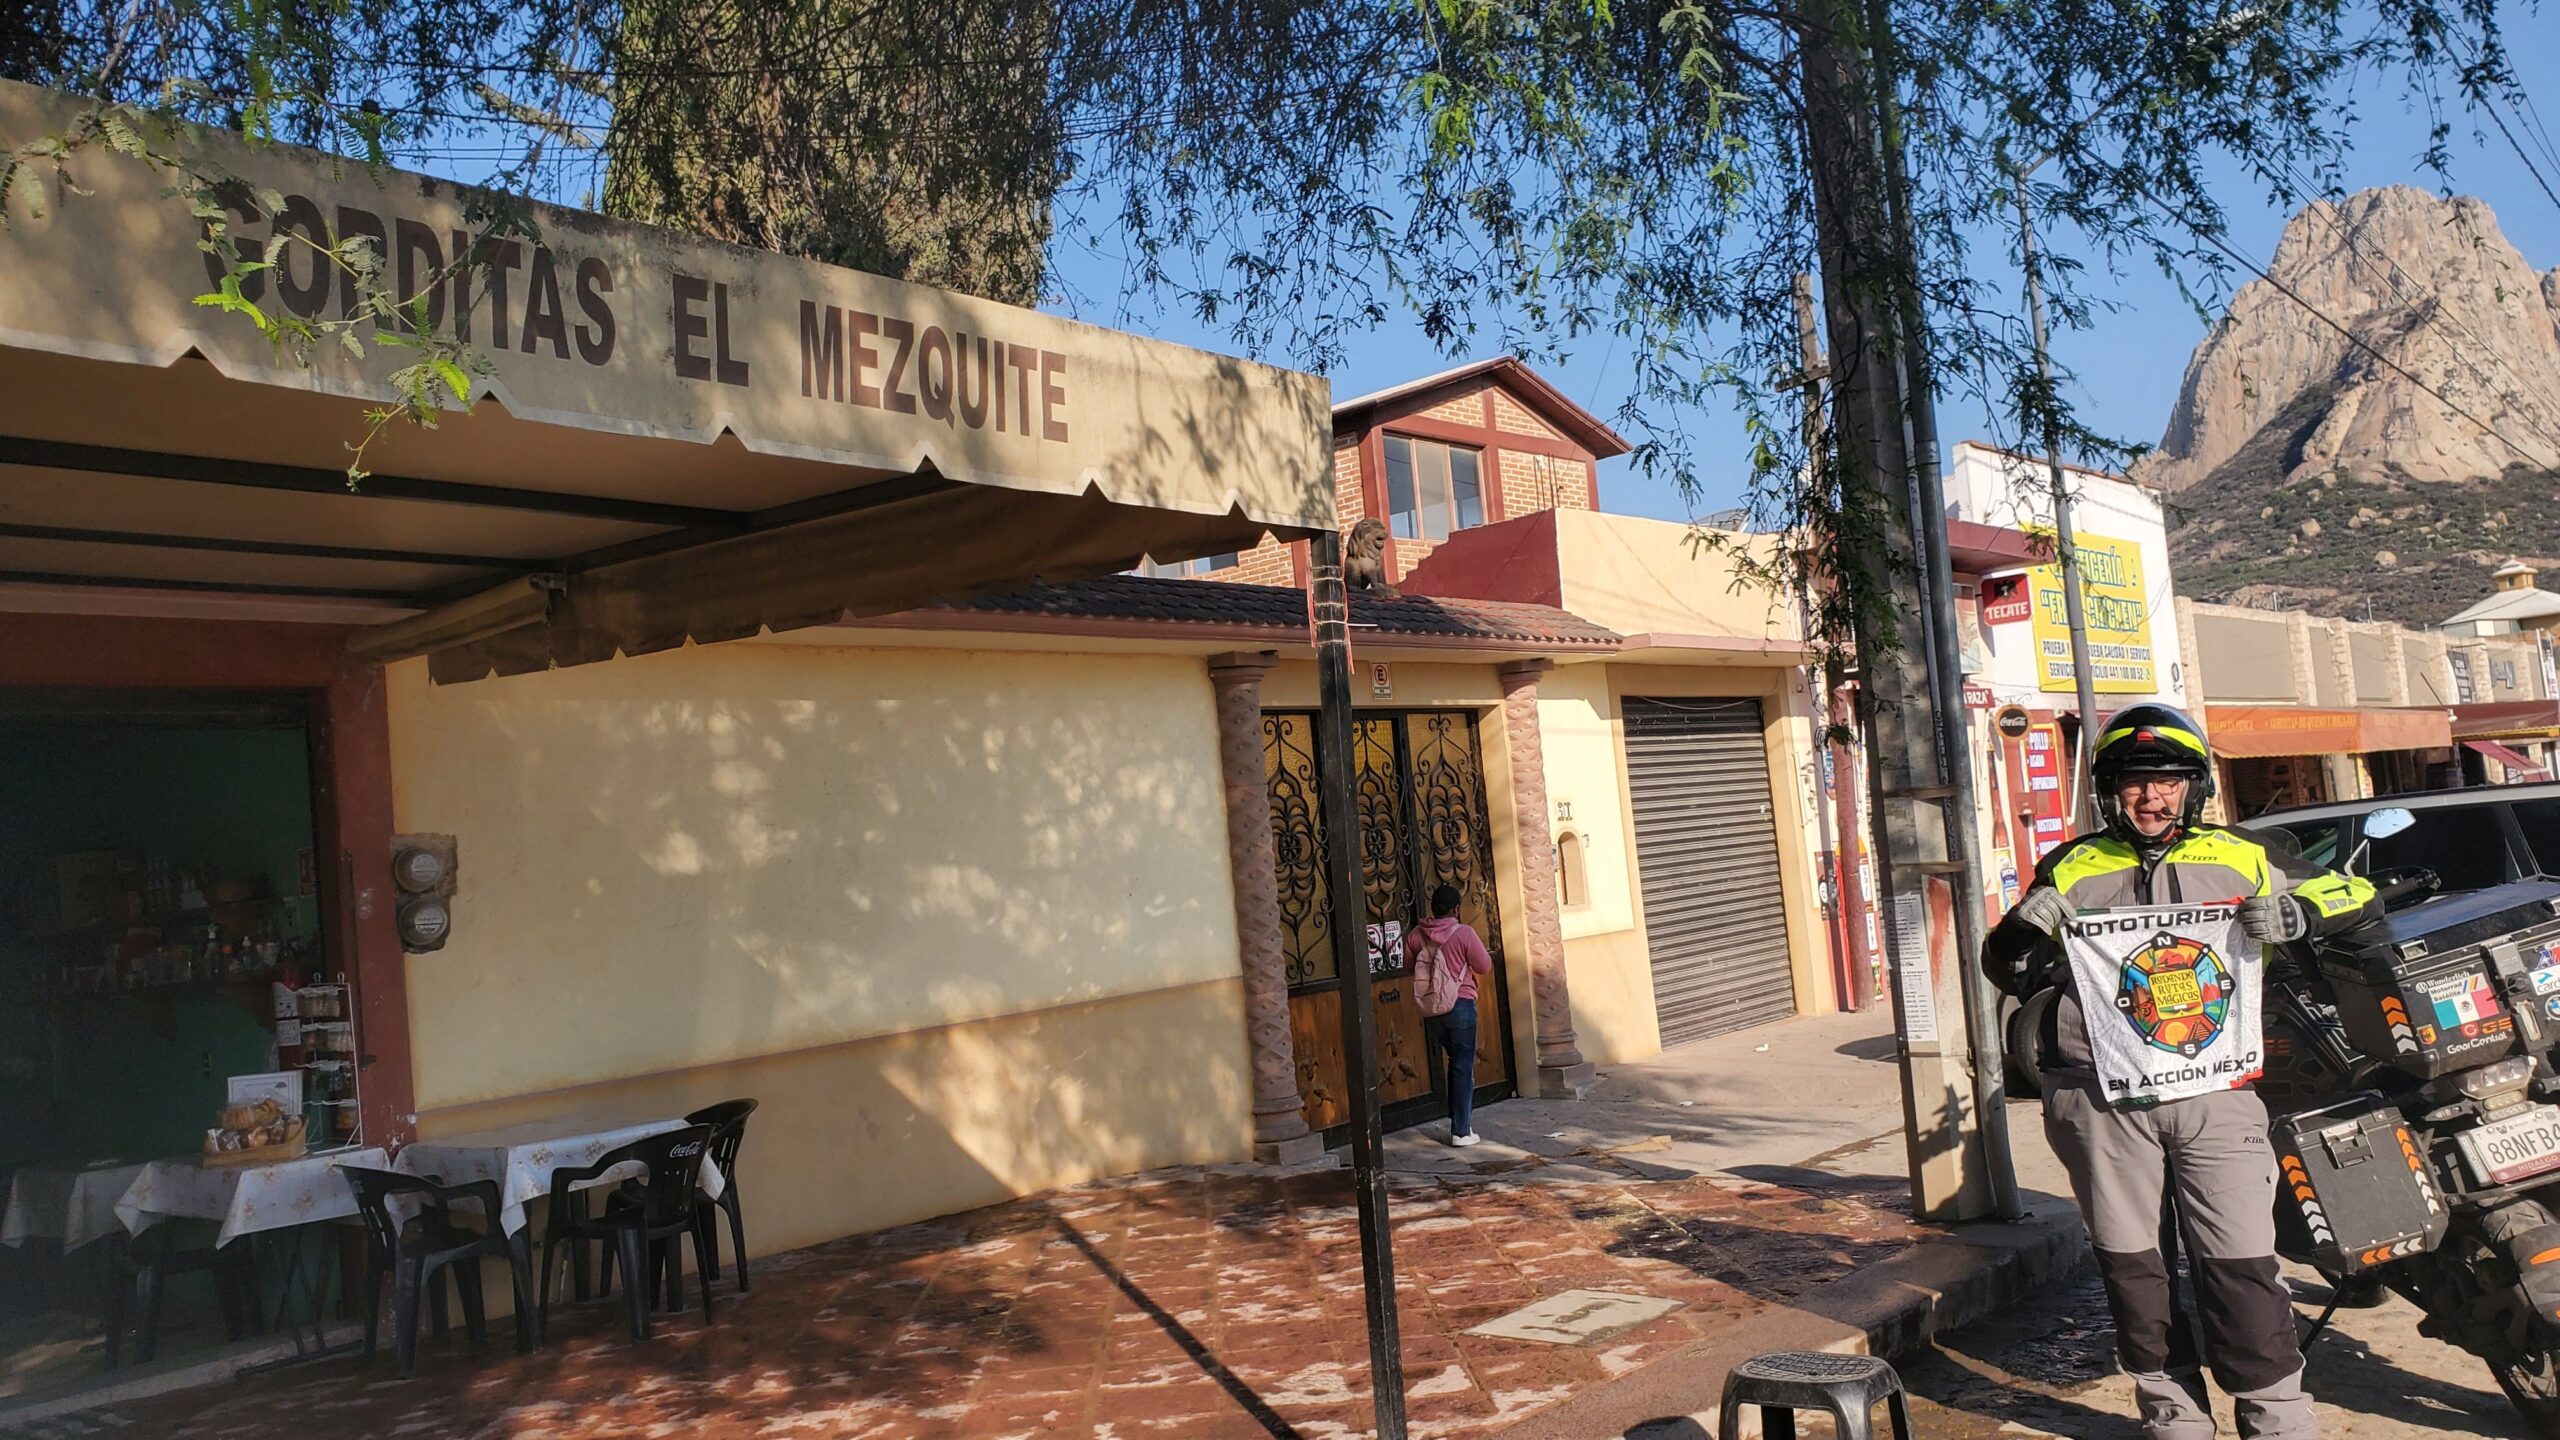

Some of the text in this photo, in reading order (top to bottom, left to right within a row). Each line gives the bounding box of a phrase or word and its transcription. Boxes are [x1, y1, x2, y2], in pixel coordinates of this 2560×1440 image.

[202, 194, 1069, 443] GORDITAS EL MEZQUITE
[1985, 601, 2029, 620] TECATE
[2157, 935, 2172, 946] N
[2220, 979, 2232, 990] E
[2427, 970, 2470, 988] Wunderlich
[2430, 981, 2463, 995] Motorrad
[2184, 1044, 2196, 1054] S
[2107, 1077, 2130, 1092] EN
[2138, 1063, 2206, 1089] ACCIÓN
[670, 1141, 701, 1158] Coca-Cola
[2517, 1154, 2558, 1172] HIDALGO
